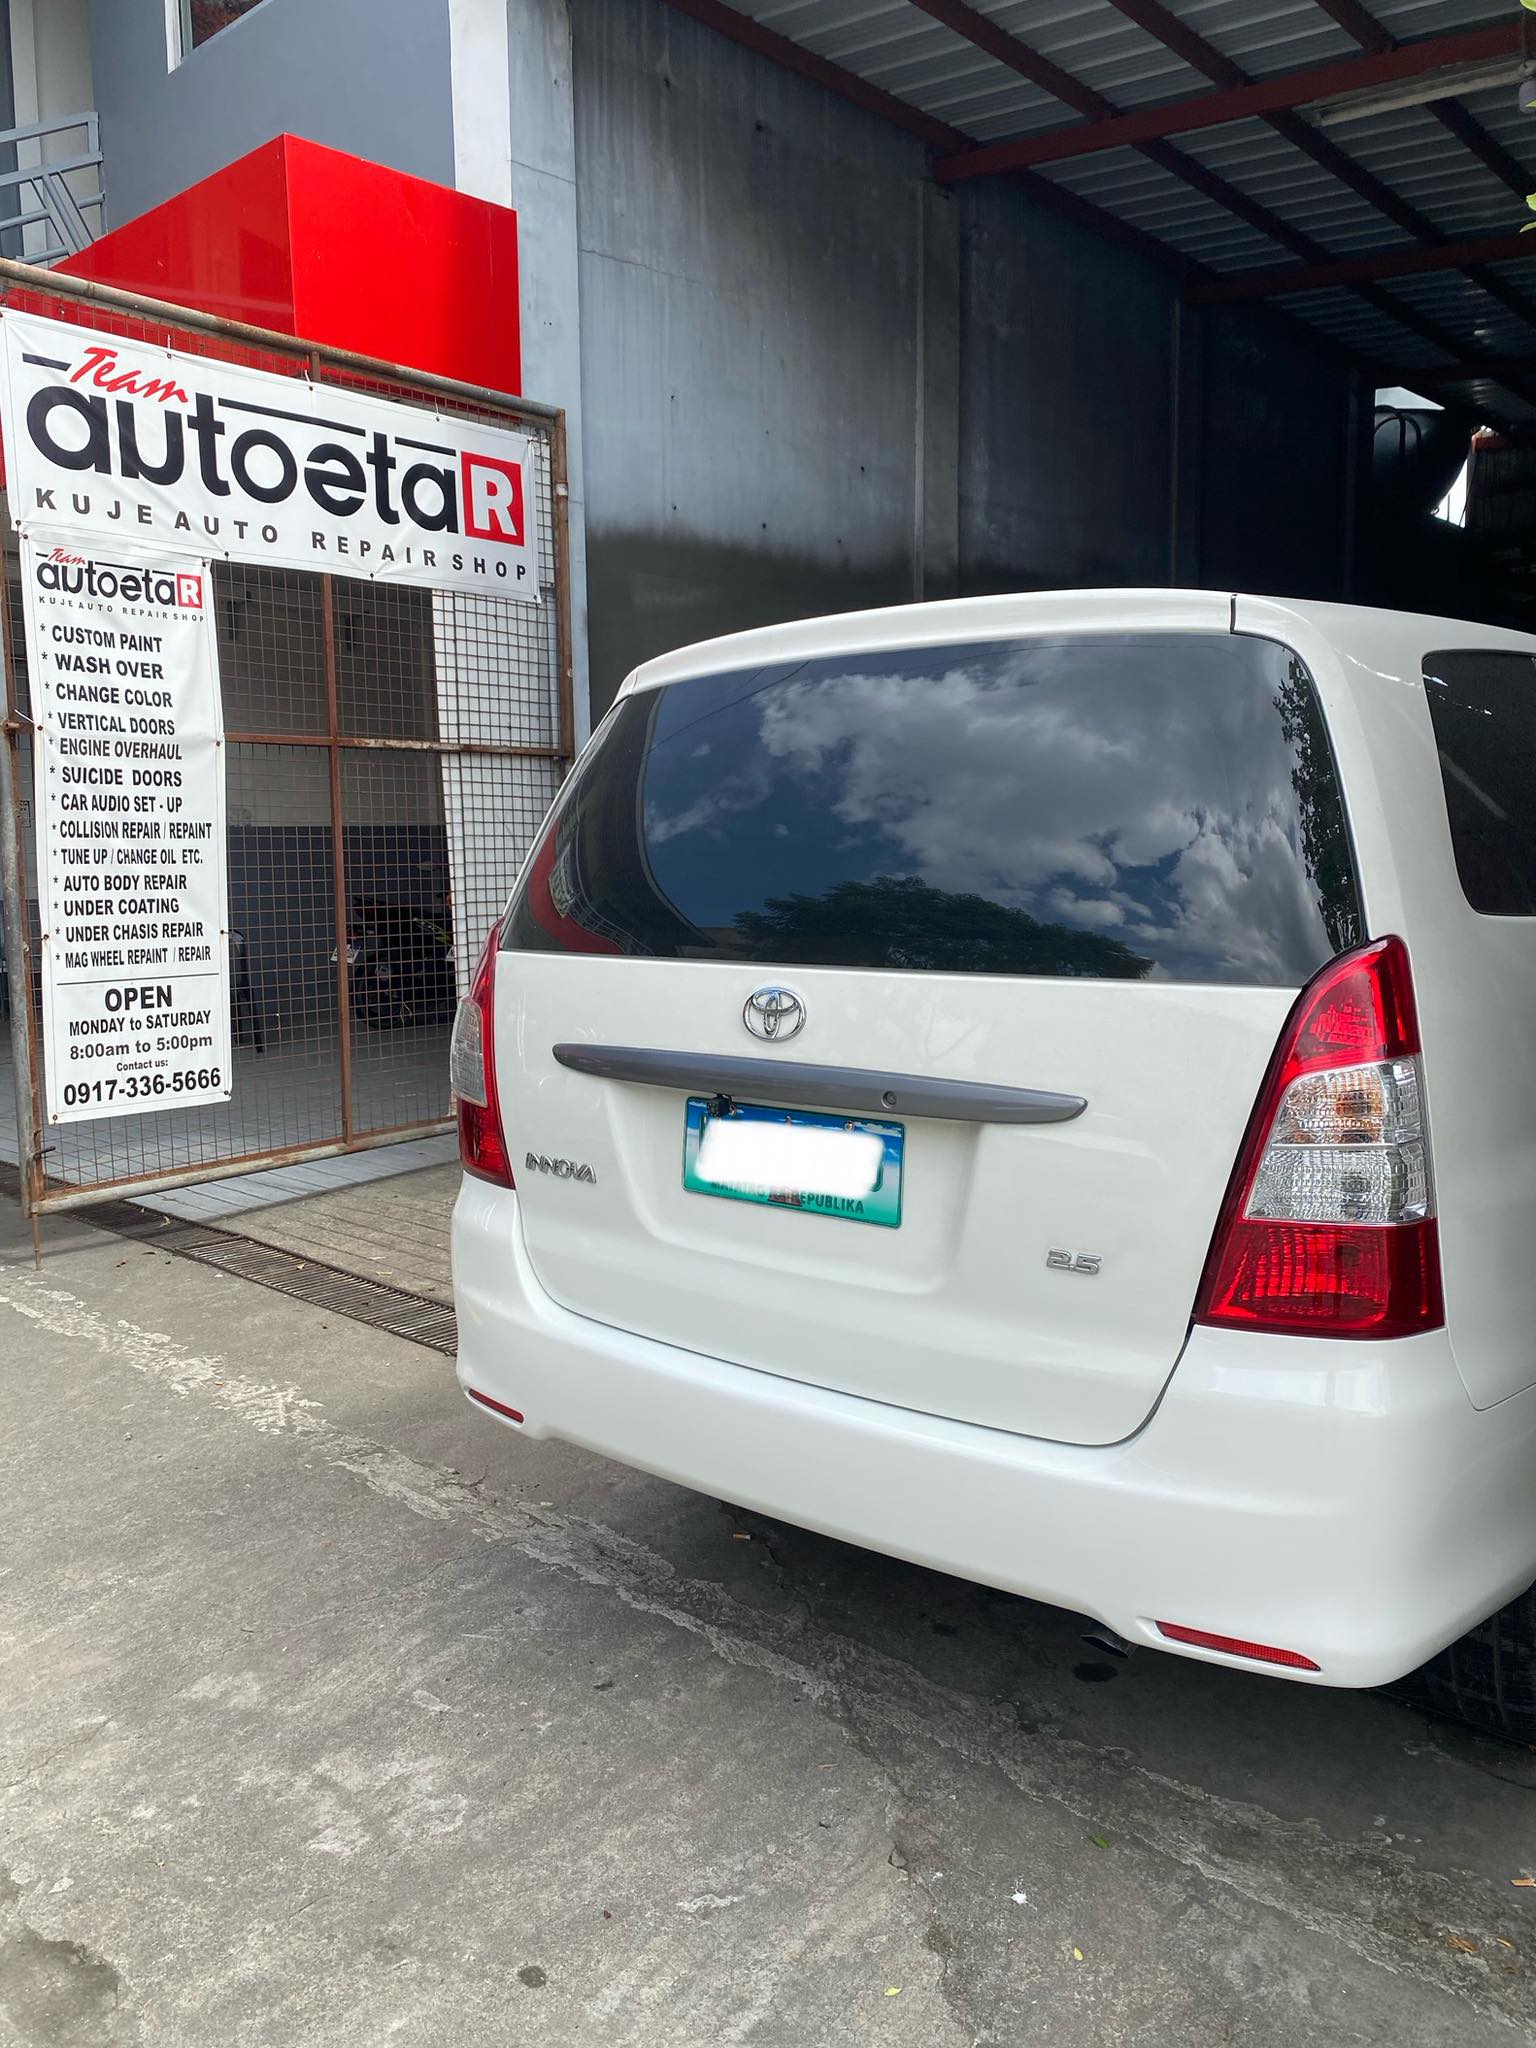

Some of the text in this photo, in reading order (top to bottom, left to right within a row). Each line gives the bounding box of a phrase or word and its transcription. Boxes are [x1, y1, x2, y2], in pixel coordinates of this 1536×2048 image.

[70, 347, 188, 402] Team
[48, 548, 86, 565] Team
[311, 531, 436, 566] REPAIR
[452, 554, 526, 580] SHOP
[123, 607, 168, 619] REPAIR
[173, 613, 204, 622] SHOP
[52, 625, 162, 653] CUSTOM PAINT
[55, 653, 164, 680] WASH OVER
[56, 683, 173, 708] CHANGE COLOR
[57, 712, 175, 736] VERTICAL DOORS
[60, 737, 182, 760] ENGINE OVERHAUL
[62, 766, 182, 787] SUICIDE DOORS
[61, 793, 88, 811] CAR
[92, 795, 130, 812] AUDIO
[134, 796, 156, 812] SET
[167, 797, 183, 813] UP
[60, 820, 119, 839] COLLISION
[122, 822, 161, 839] REPAIR
[170, 822, 212, 839] REPAINT
[61, 848, 90, 864] TUNE
[93, 849, 108, 864] UP
[117, 848, 157, 865] CHANGE
[160, 848, 176, 864] OIL
[182, 848, 203, 864] ETC.
[64, 874, 187, 892] AUTO BODY REPAIR
[64, 897, 179, 916] UNDER COATING
[66, 921, 204, 943] UNDER CHASIS REPAIR
[65, 952, 88, 969] MAG
[91, 949, 125, 967] WHEEL
[127, 948, 168, 965] REPAINT
[178, 946, 211, 963] REPAIR
[105, 985, 173, 1012] OPEN
[69, 1010, 211, 1036] MONDAY to SATURDAY
[70, 1035, 212, 1060] 8:00am to 5:00pm
[116, 1059, 168, 1072] Contact us:
[64, 1067, 221, 1106] 0917-336-5666
[525, 1152, 597, 1184] INNOVA
[1046, 1248, 1102, 1275] 2.5
